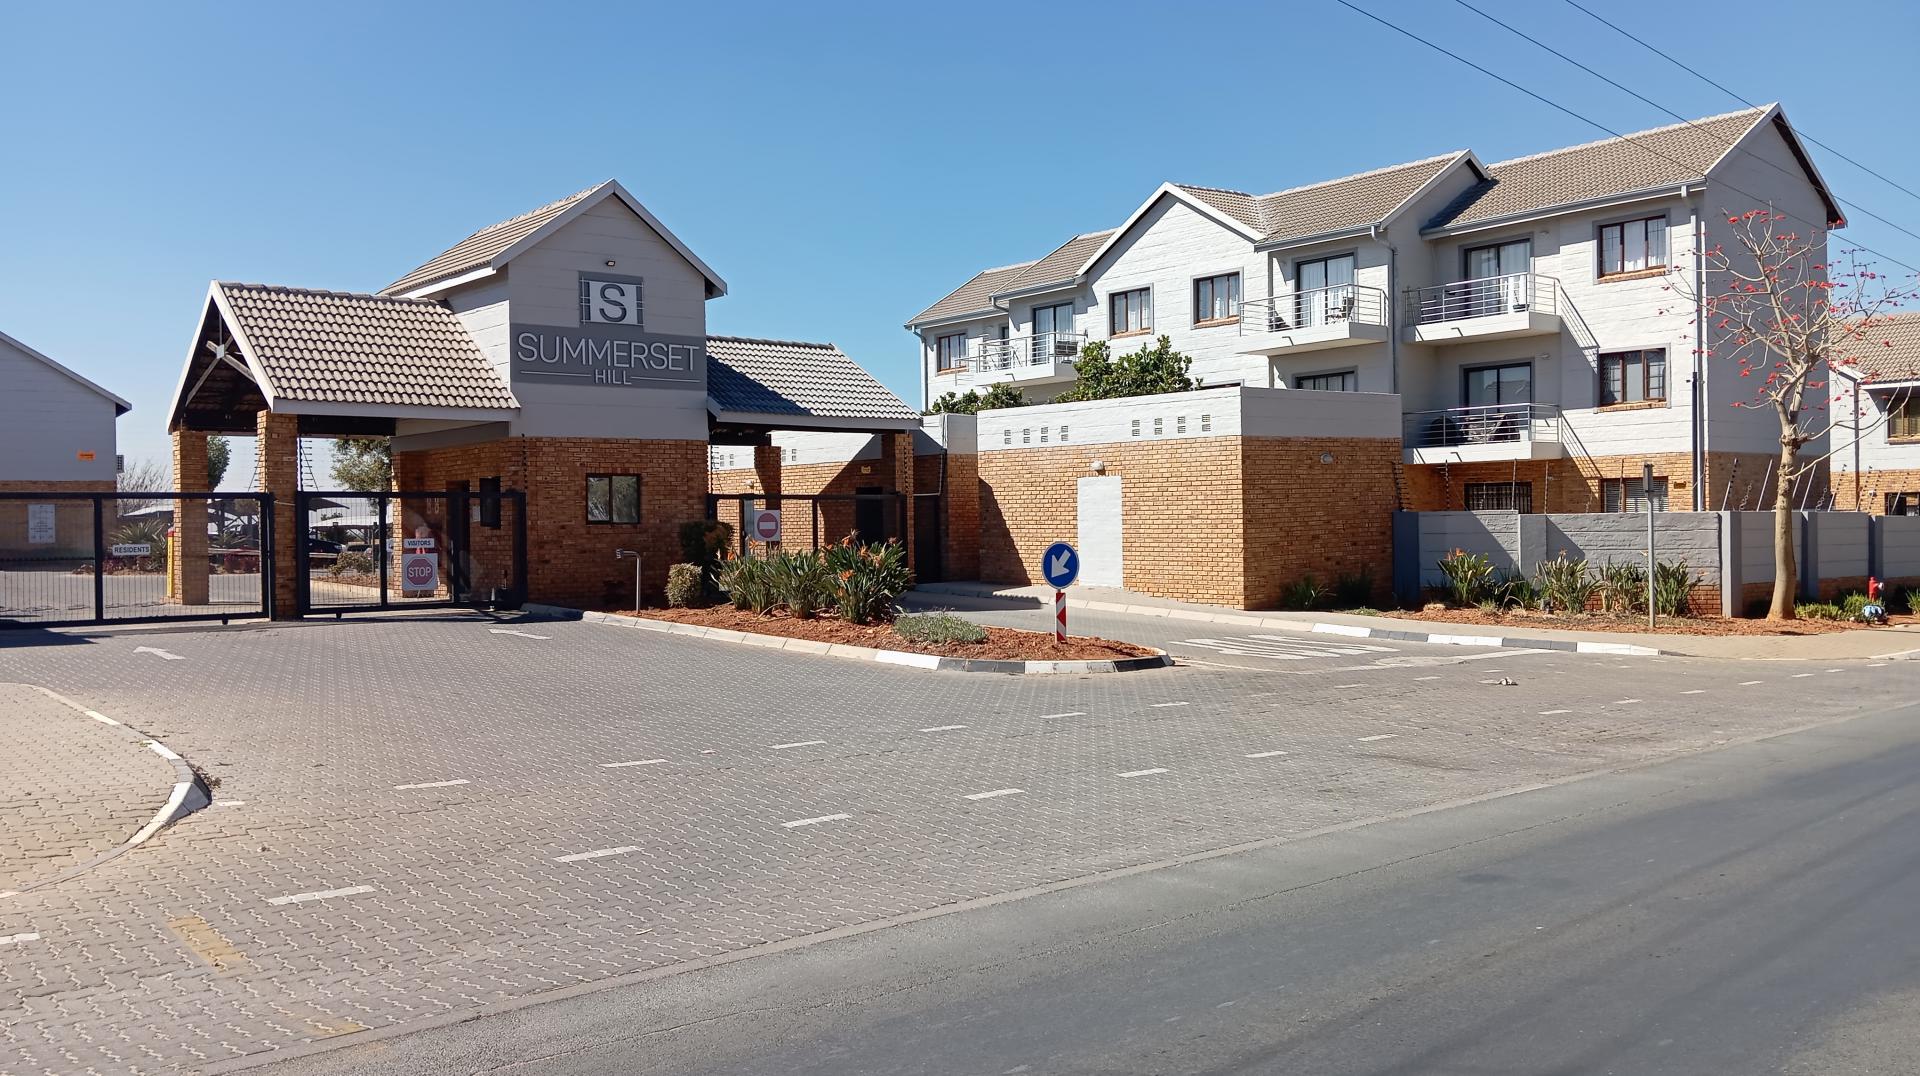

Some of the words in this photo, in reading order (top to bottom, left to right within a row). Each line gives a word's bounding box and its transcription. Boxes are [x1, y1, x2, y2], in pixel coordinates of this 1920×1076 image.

[517, 332, 700, 371] SUMMERSET
[594, 369, 632, 385] HILL
[408, 566, 431, 577] STOP
